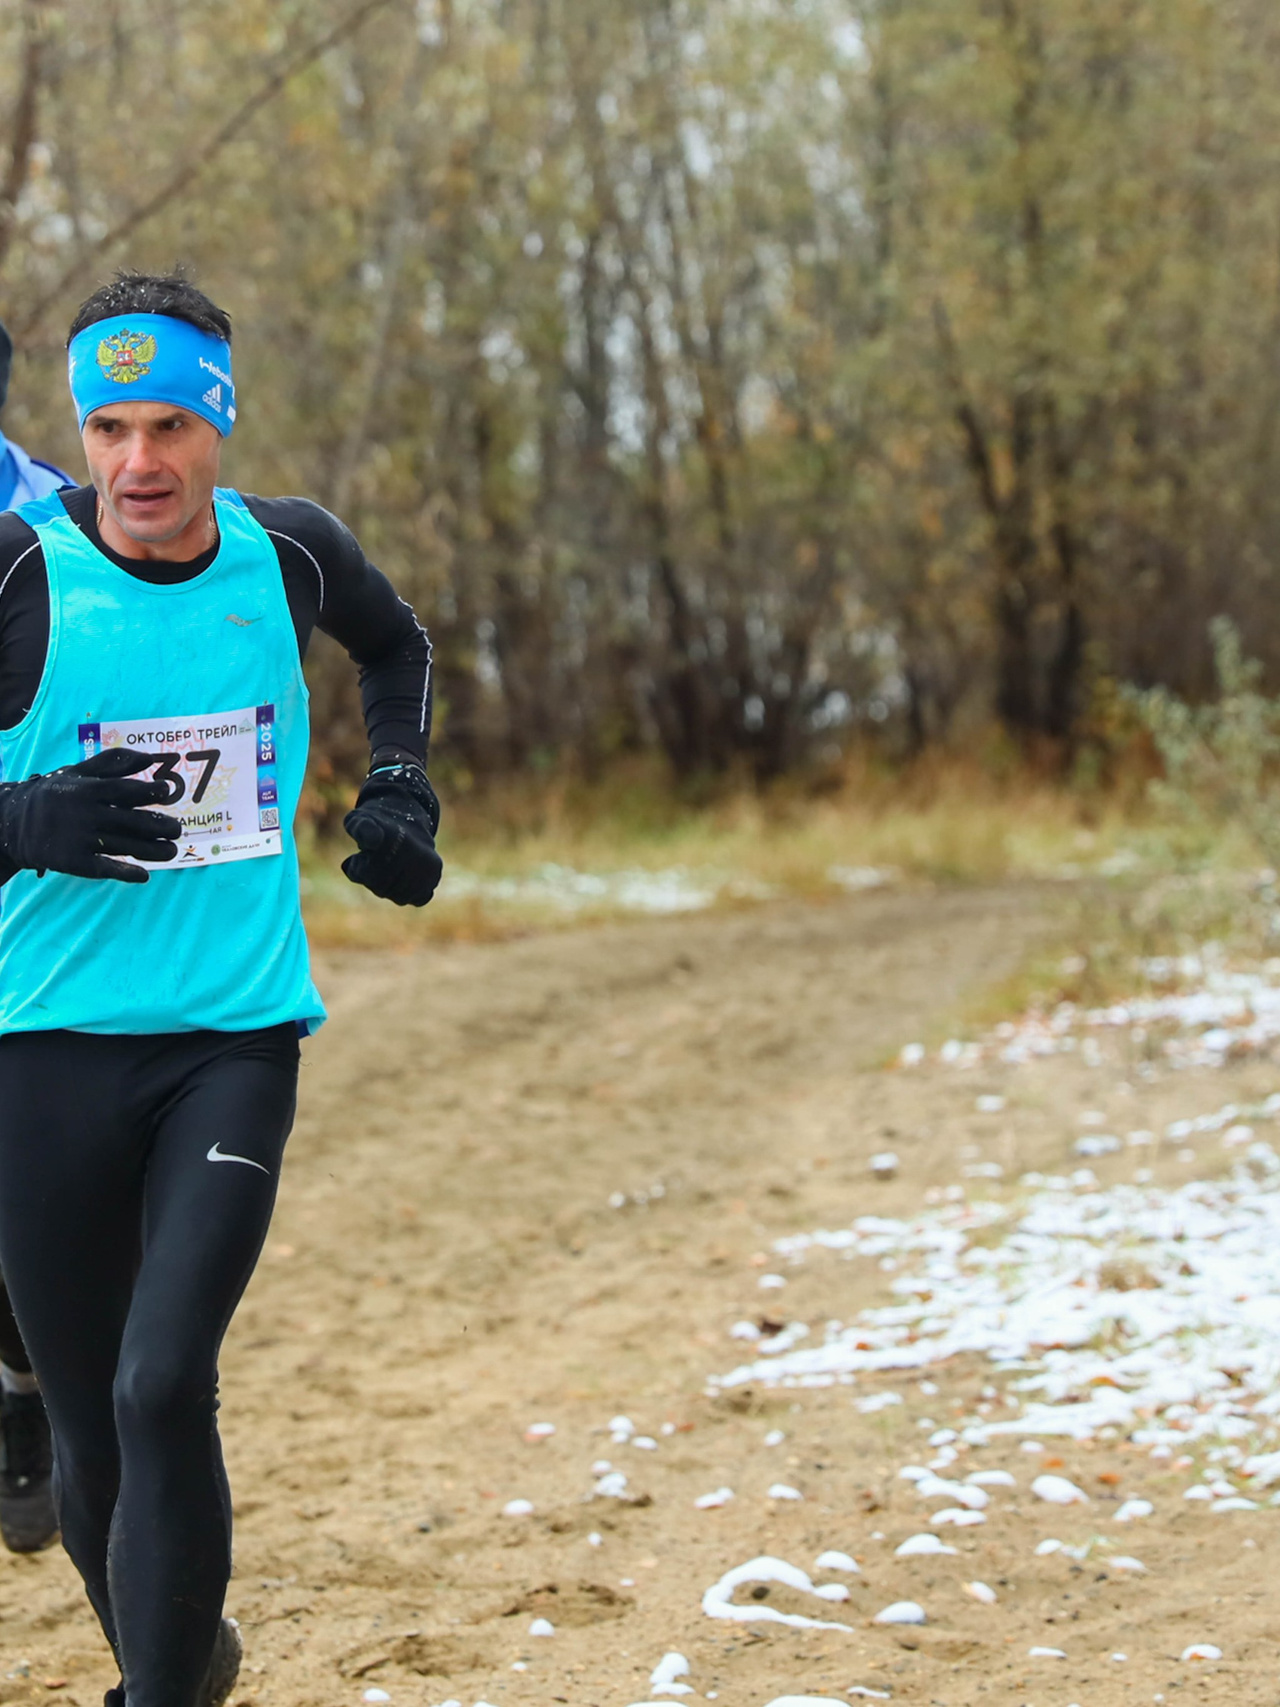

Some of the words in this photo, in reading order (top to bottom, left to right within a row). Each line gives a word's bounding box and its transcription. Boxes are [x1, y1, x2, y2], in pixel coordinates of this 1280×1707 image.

[126, 730, 192, 745] ОКТОБЕР
[197, 724, 238, 740] ТРЕЙЛ
[260, 722, 273, 761] 2025
[83, 738, 95, 761] RIES
[150, 749, 221, 805] 37
[176, 811, 223, 827] АНЦИЯ
[226, 810, 233, 821] L
